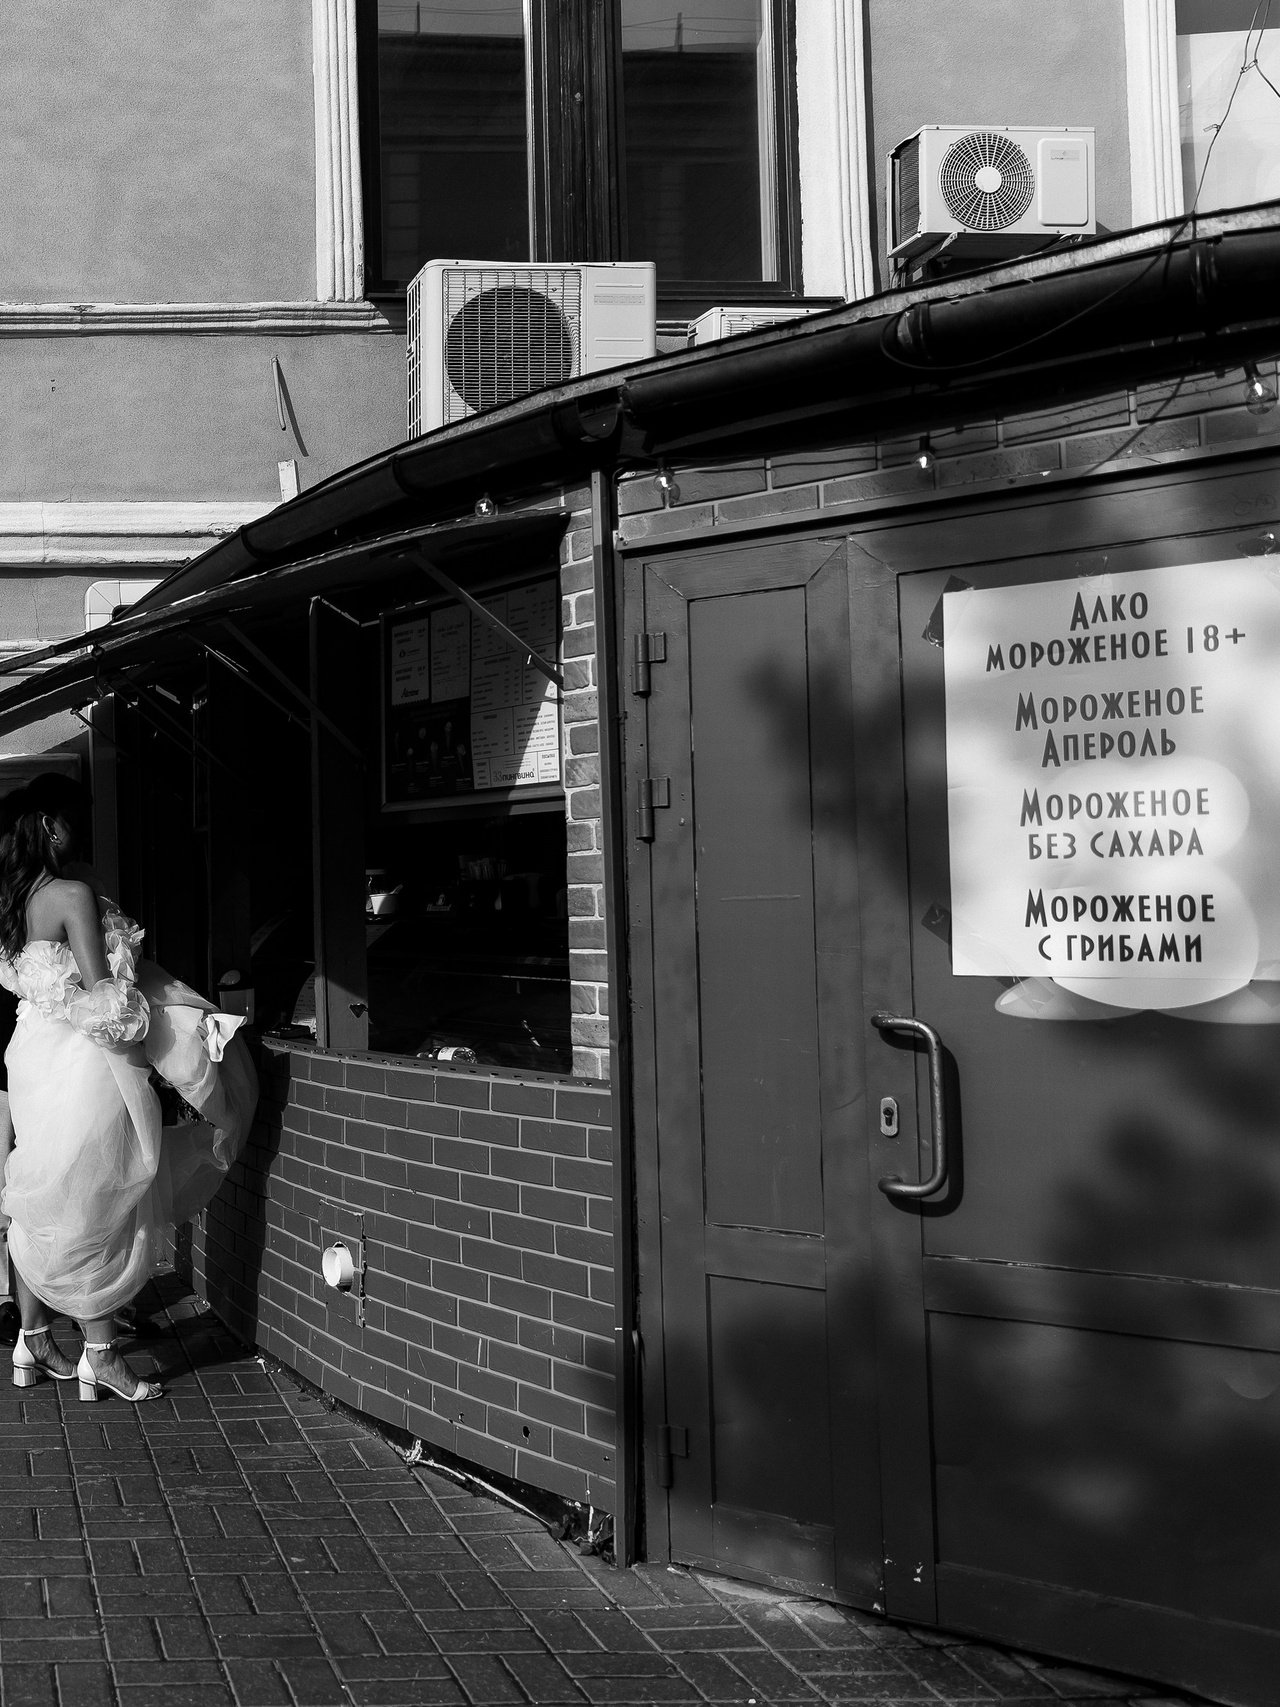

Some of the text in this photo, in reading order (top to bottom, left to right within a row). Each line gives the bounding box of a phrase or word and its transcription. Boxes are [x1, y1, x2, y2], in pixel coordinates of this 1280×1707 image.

[1069, 591, 1149, 631] АЛКО
[985, 624, 1247, 672] МОРОЖЕНОЕ 18+
[1015, 686, 1205, 731] МОРОЖЕНОЕ
[1041, 728, 1177, 768] АПЕРОЛЬ
[1020, 787, 1210, 827] МОРОЖЕНОЕ
[1028, 828, 1204, 860] БЕЗ САХАРА
[1025, 888, 1216, 928] МОРОЖЕНОЕ
[1038, 934, 1202, 963] С ГРИБАМИ
